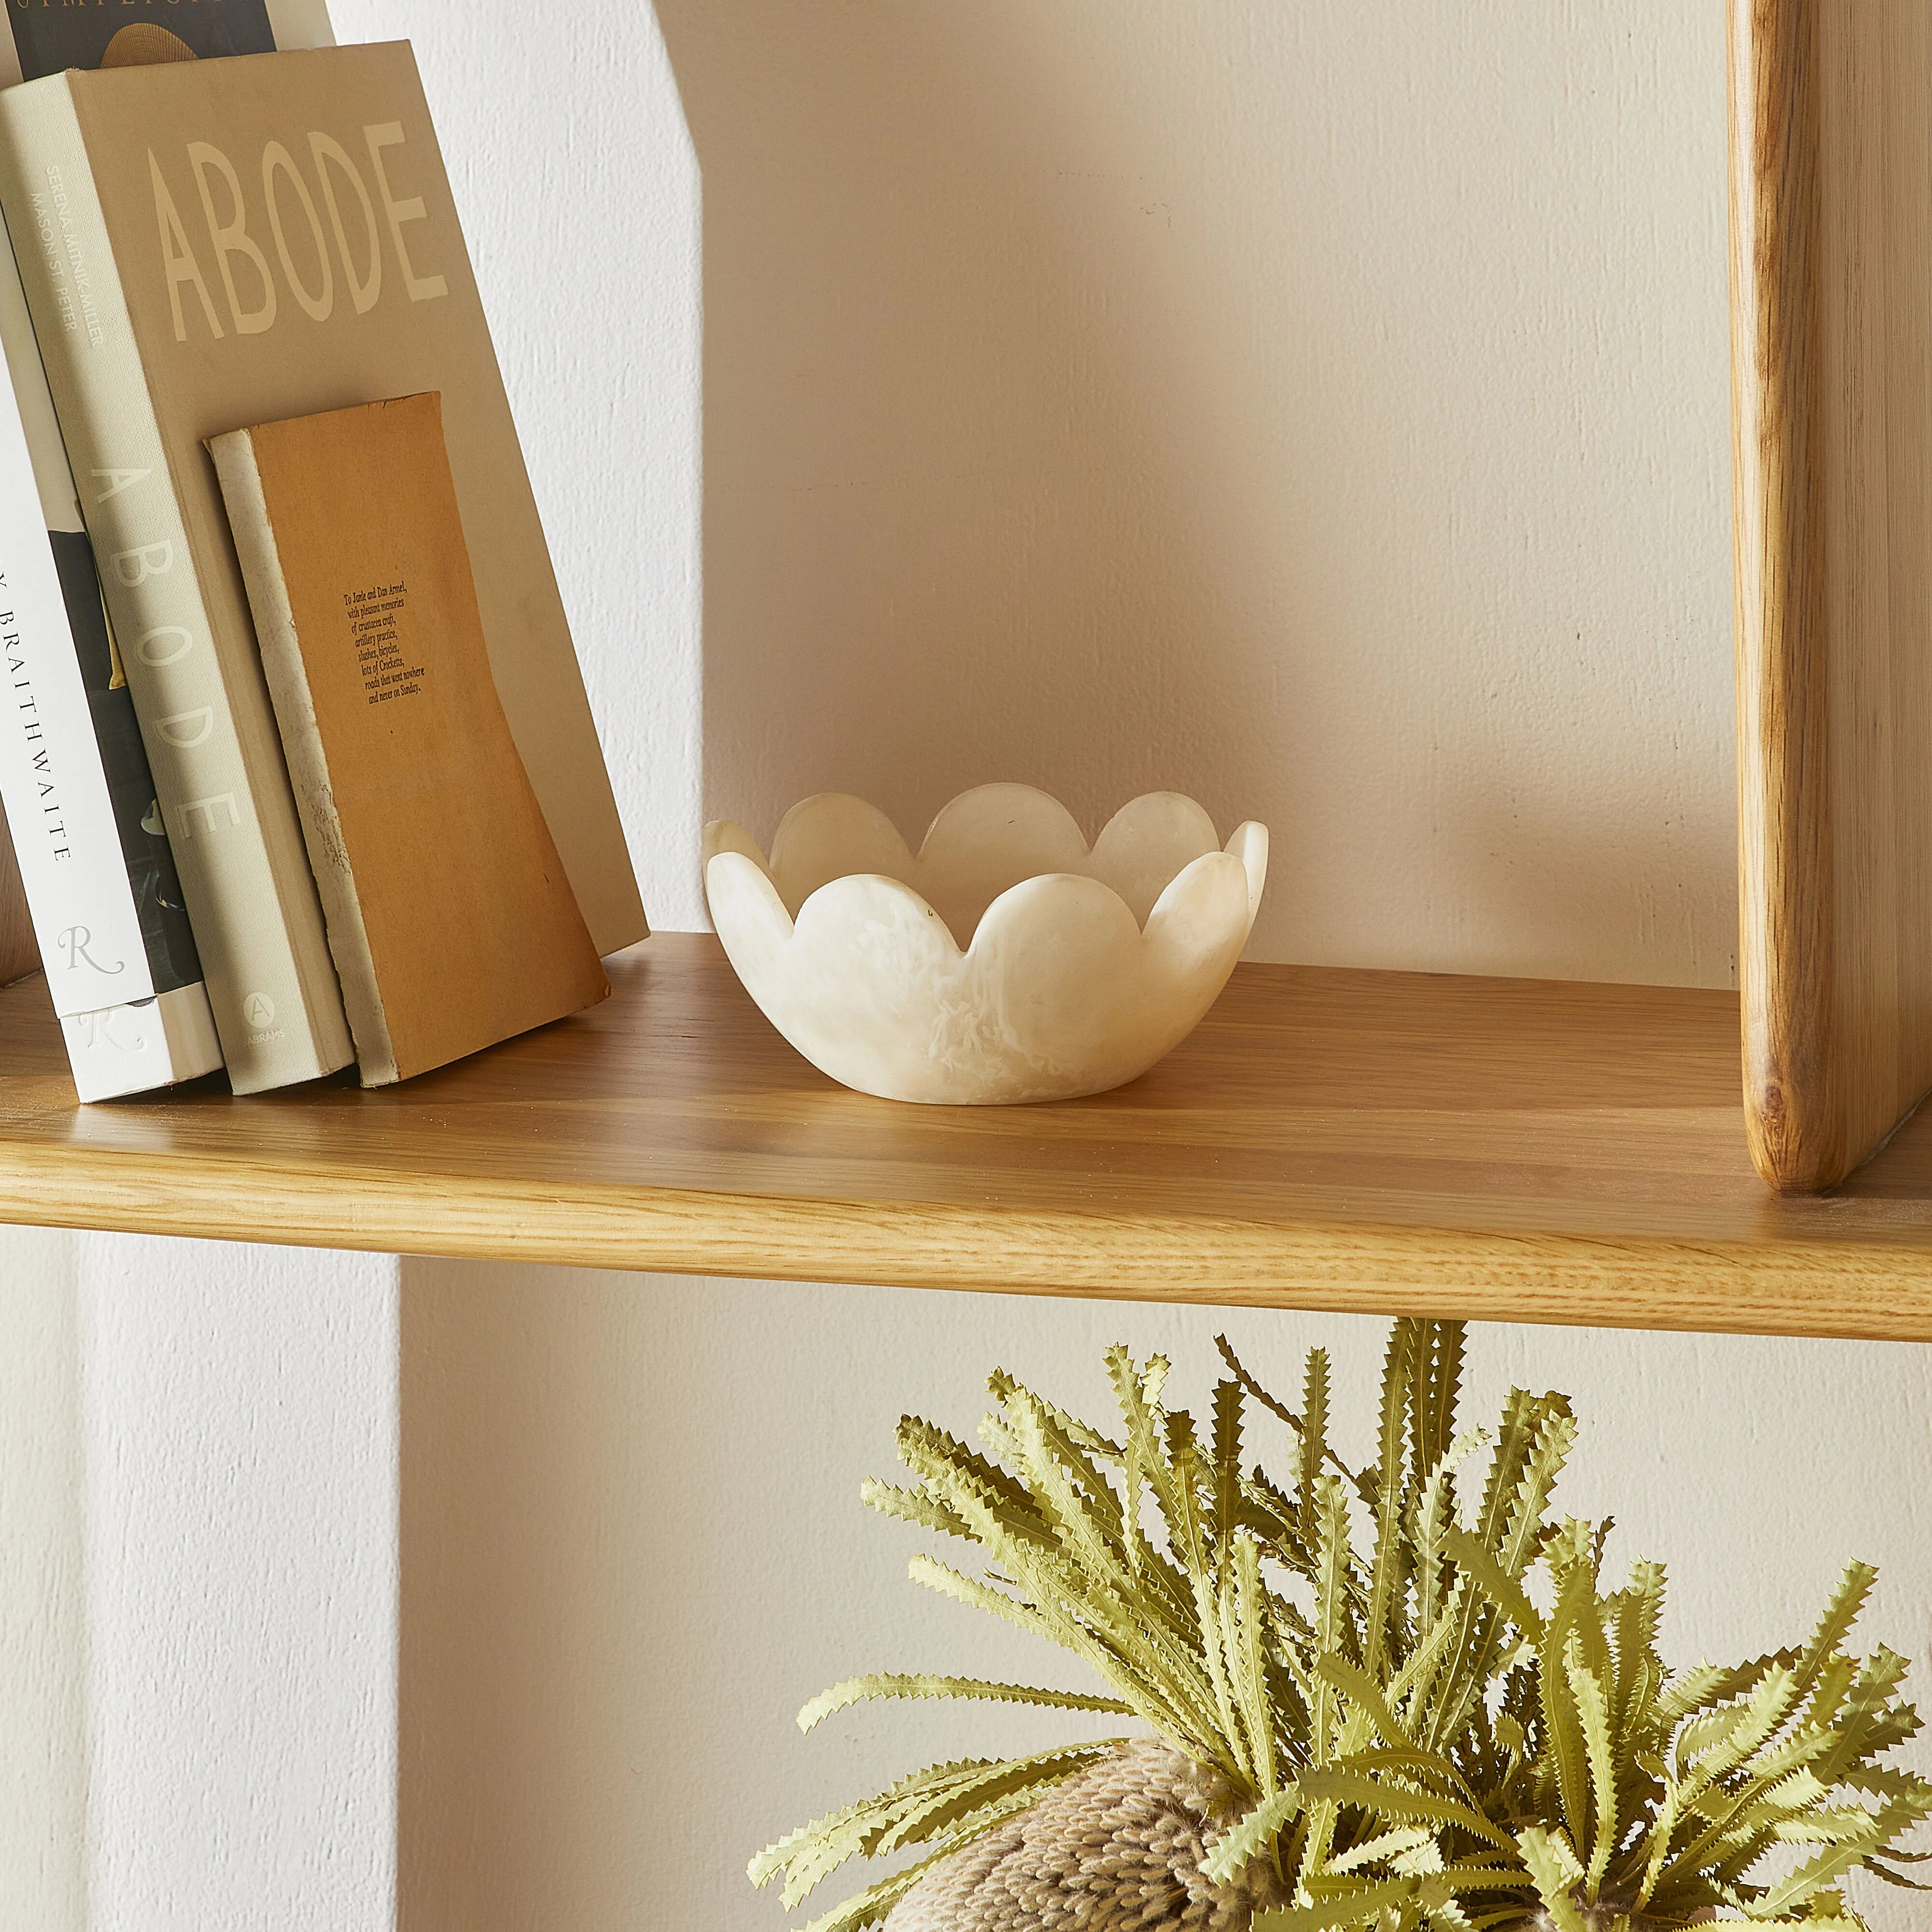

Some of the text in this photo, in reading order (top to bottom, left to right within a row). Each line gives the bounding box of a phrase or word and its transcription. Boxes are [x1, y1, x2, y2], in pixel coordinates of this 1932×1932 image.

[46, 165, 73, 229] SERENA
[148, 121, 448, 341] ABODE
[30, 193, 57, 256] MASON
[56, 287, 76, 332] PETER
[344, 595, 351, 605] To
[367, 587, 376, 600] and
[377, 587, 387, 597] Dan
[348, 597, 404, 619] with pleasant memories
[352, 613, 396, 636] of crustacea craft,
[355, 629, 398, 647] artillery practice,
[378, 642, 399, 657] bicycles,
[91, 468, 242, 839] ABODE
[361, 657, 404, 676] lots of Crocketts,
[365, 667, 424, 690] roads that went nowhere
[369, 682, 421, 704] and never on Sunday.
[0, 609, 71, 861] BRAITHWAITE
[57, 925, 125, 974] R
[247, 1029, 284, 1044] ABRAMS
